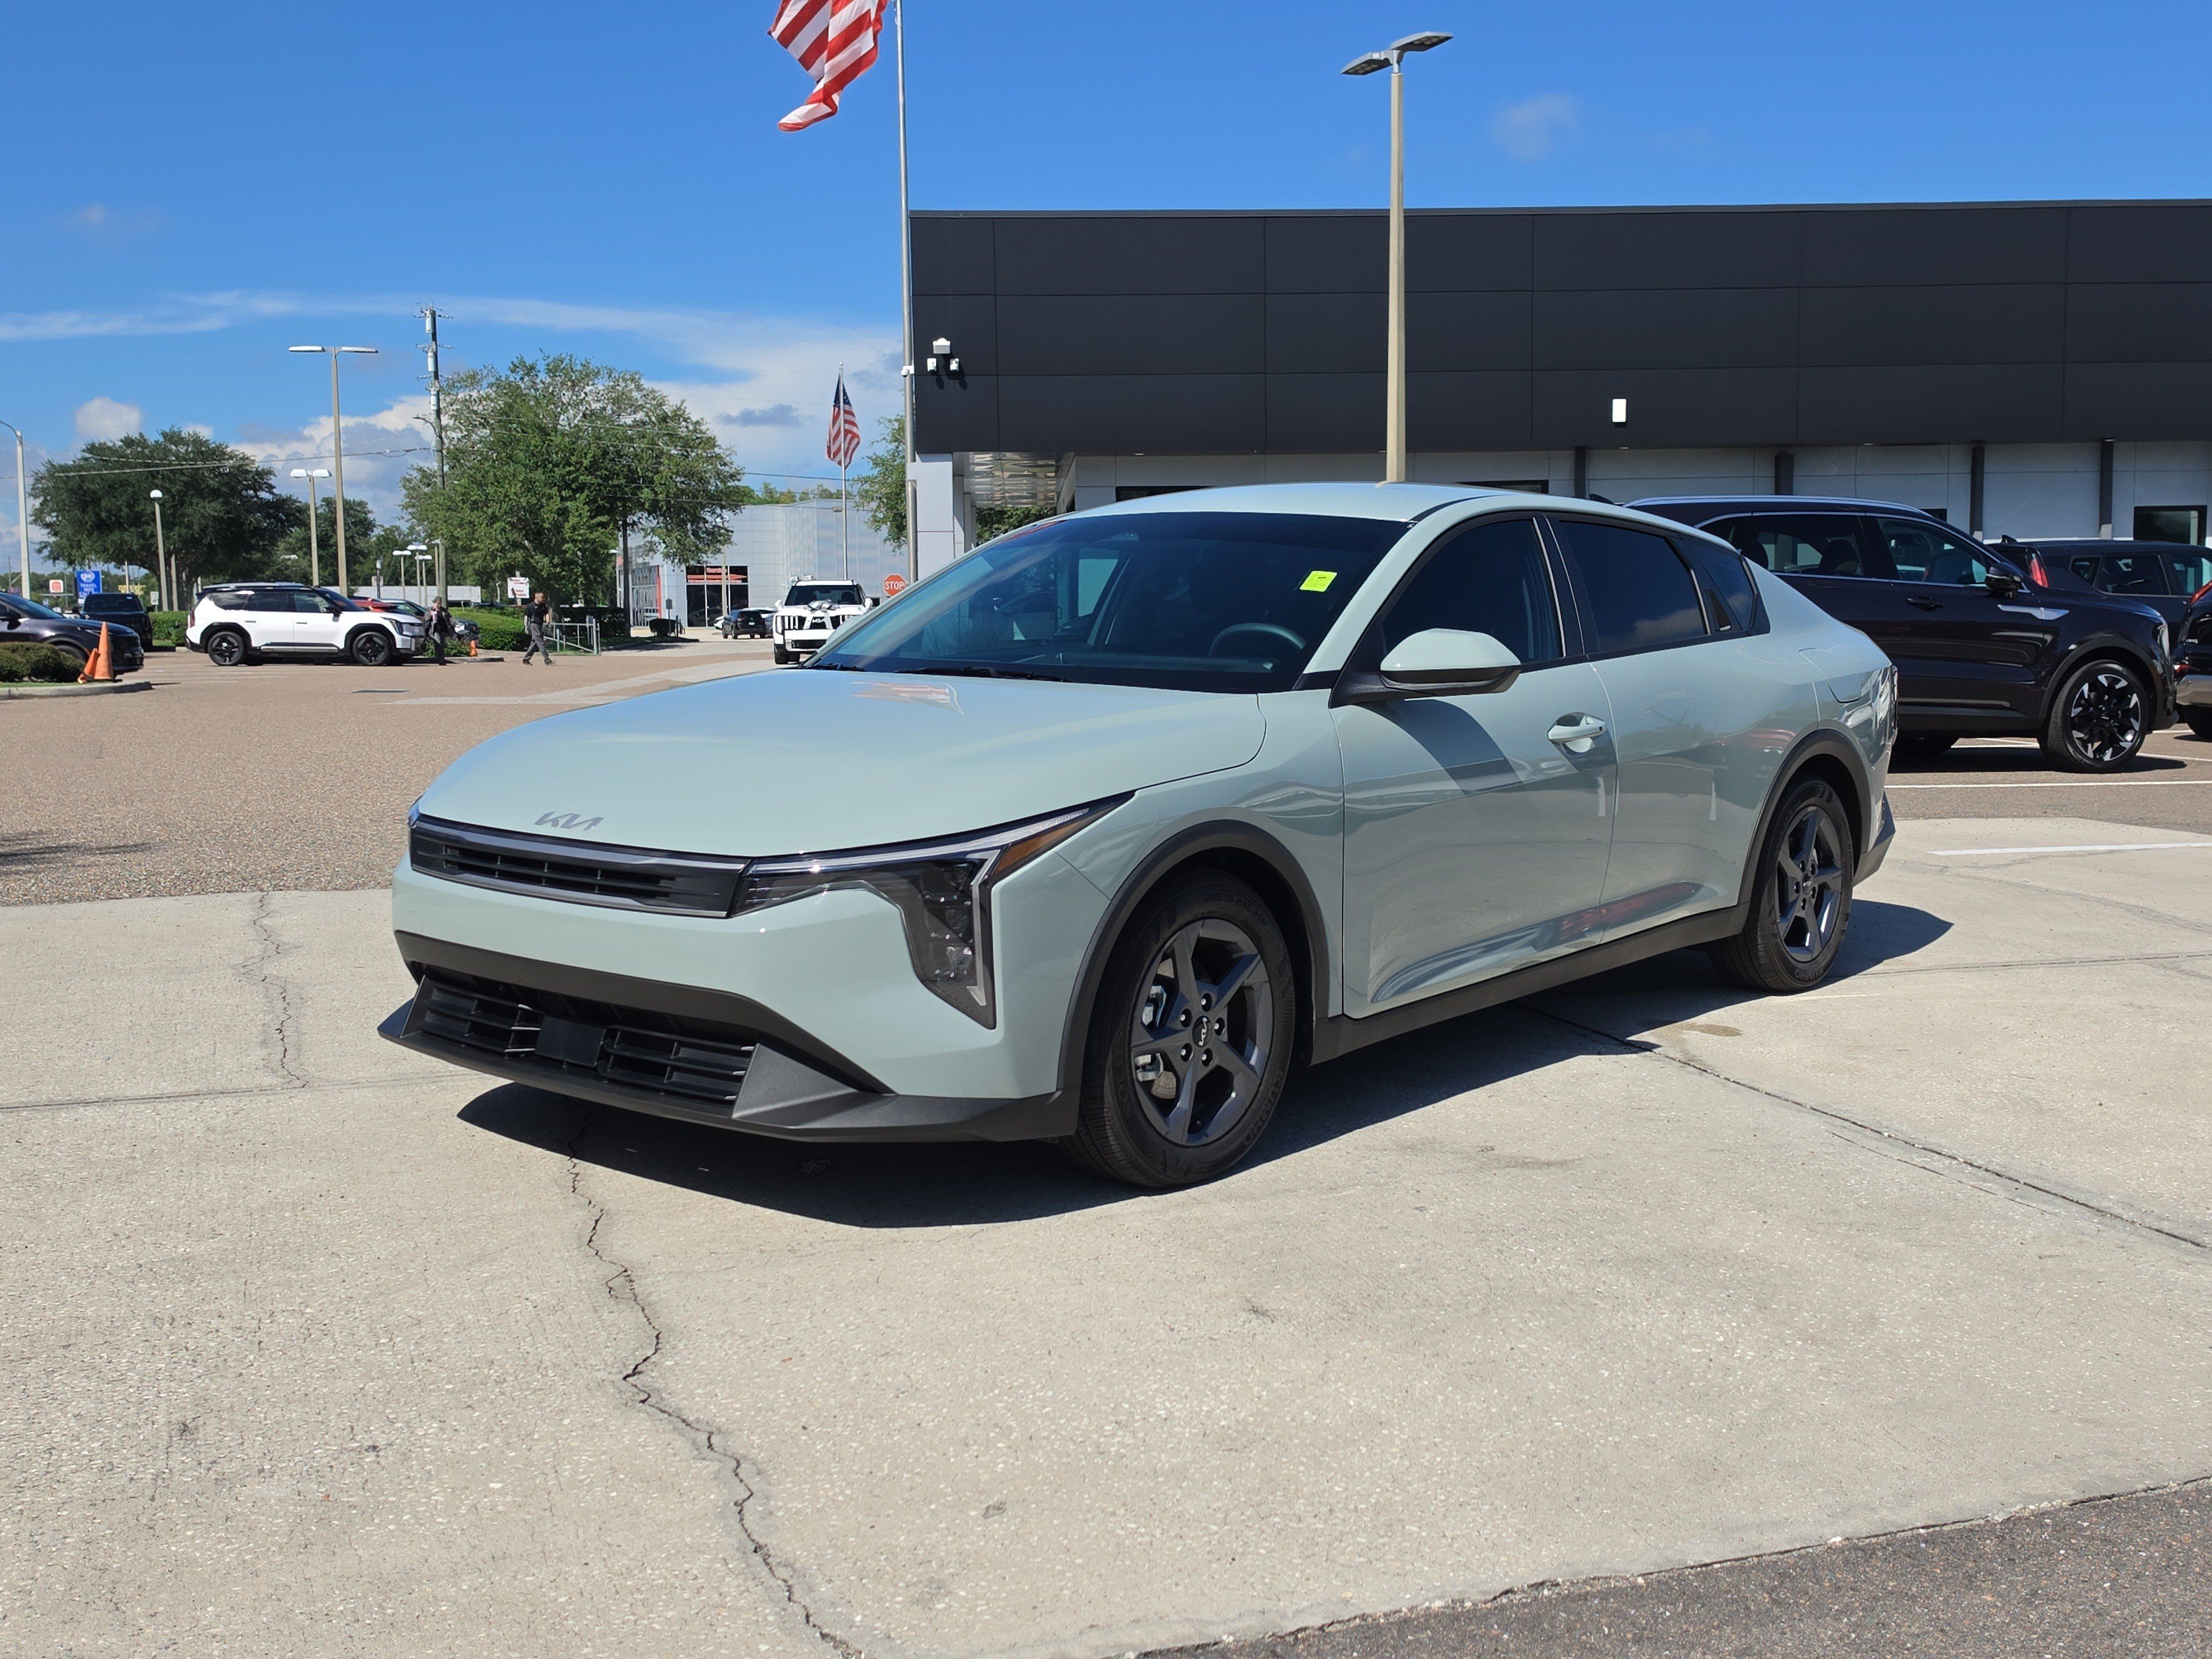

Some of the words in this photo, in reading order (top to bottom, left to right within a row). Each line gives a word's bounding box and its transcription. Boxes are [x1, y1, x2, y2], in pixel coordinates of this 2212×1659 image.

[885, 581, 904, 590] STOP
[534, 811, 604, 832] KIA
[1795, 967, 1823, 981] KUMHO
[1199, 1017, 1208, 1046] KIA
[1243, 1070, 1284, 1146] KUMHO
